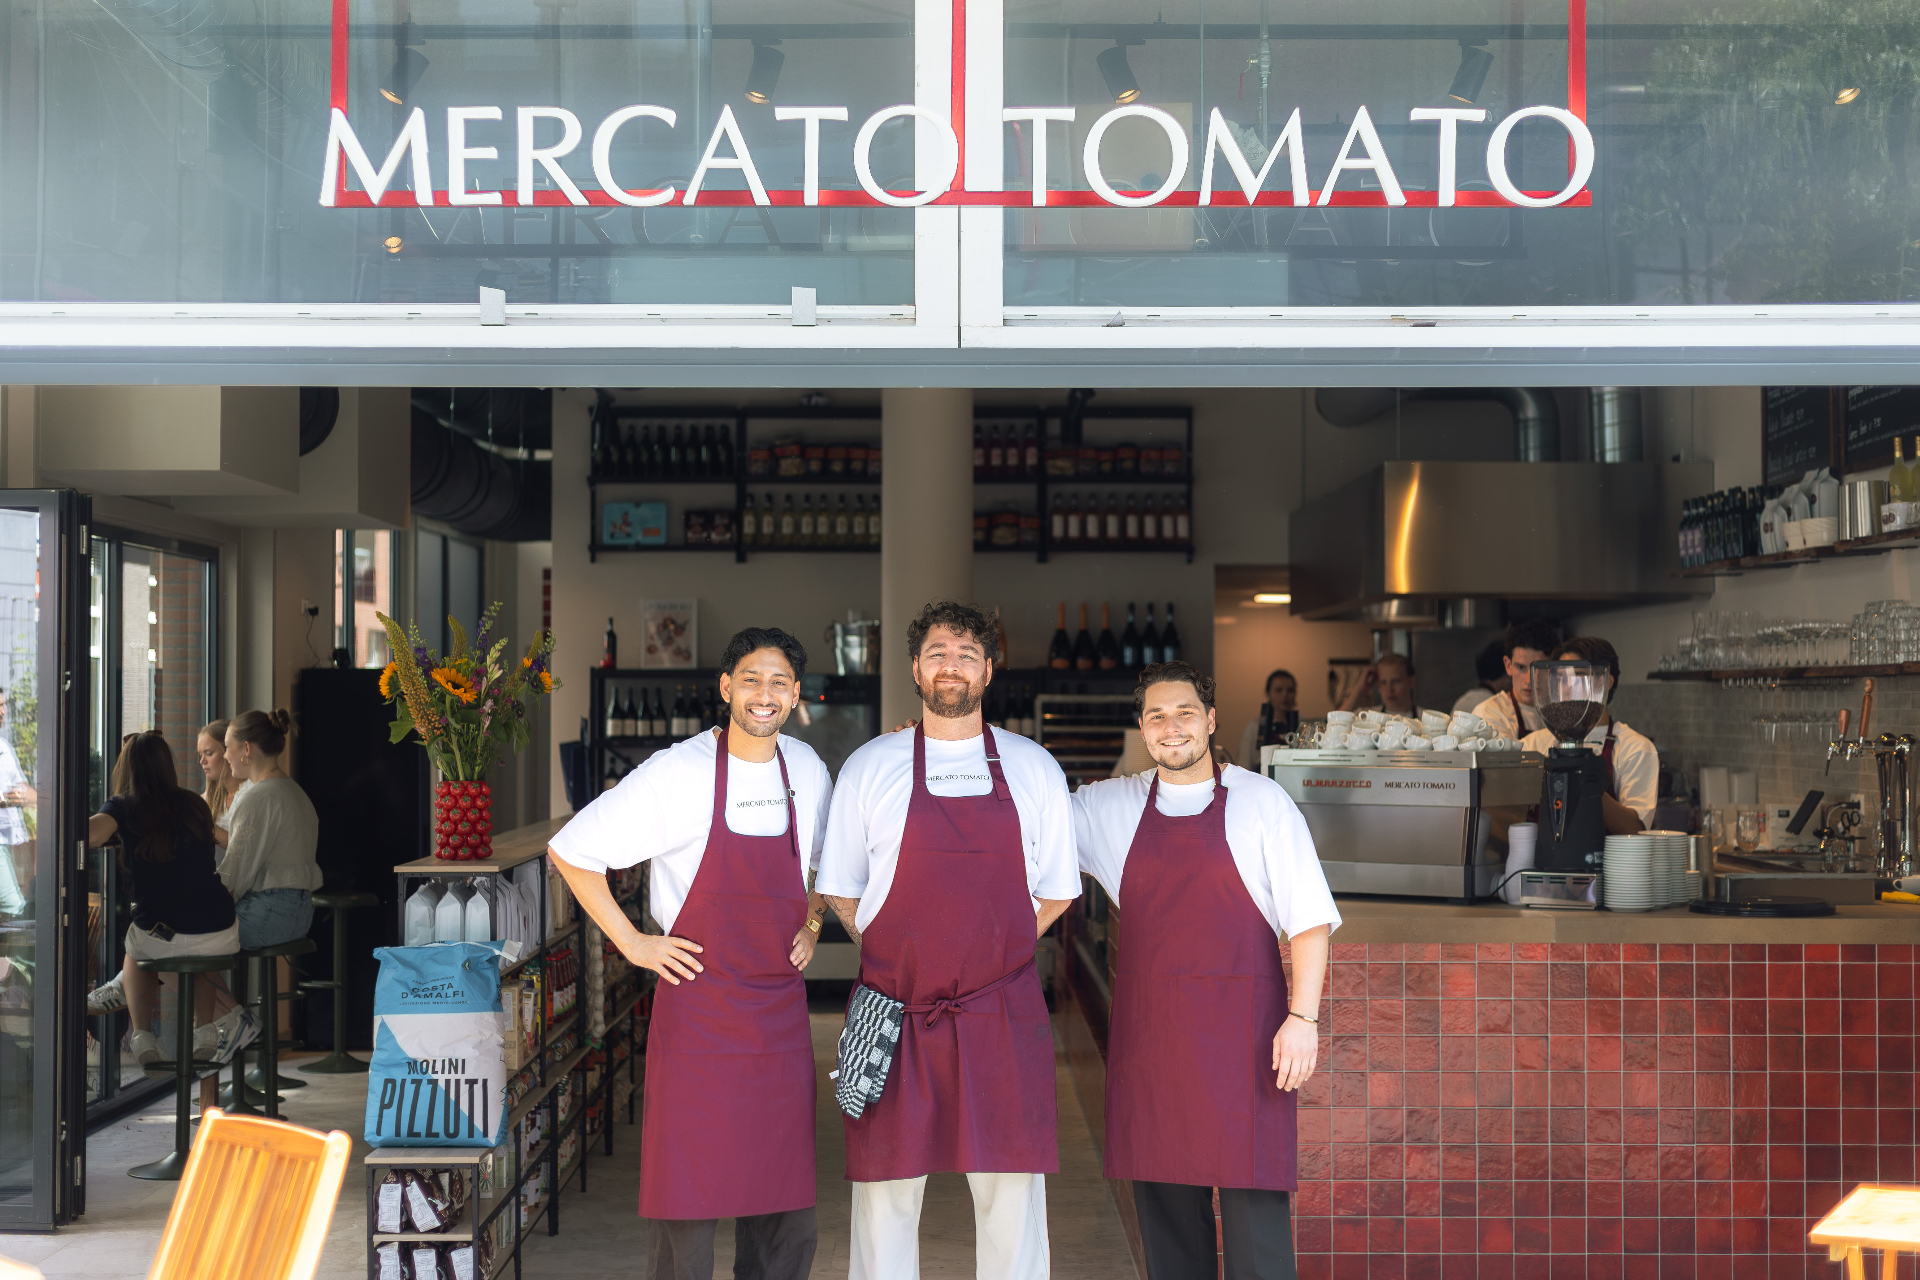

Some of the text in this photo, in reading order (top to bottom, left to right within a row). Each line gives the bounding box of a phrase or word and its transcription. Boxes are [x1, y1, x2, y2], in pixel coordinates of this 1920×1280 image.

[319, 104, 1595, 207] MERCATO TOMATO
[1384, 781, 1456, 790] MERCATO TOMATO
[736, 799, 766, 808] MERCATO
[411, 982, 454, 993] COSTA
[401, 991, 465, 999] D'AMALFI
[407, 1058, 466, 1075] MOLINI
[376, 1078, 489, 1139] PIZZUTI
